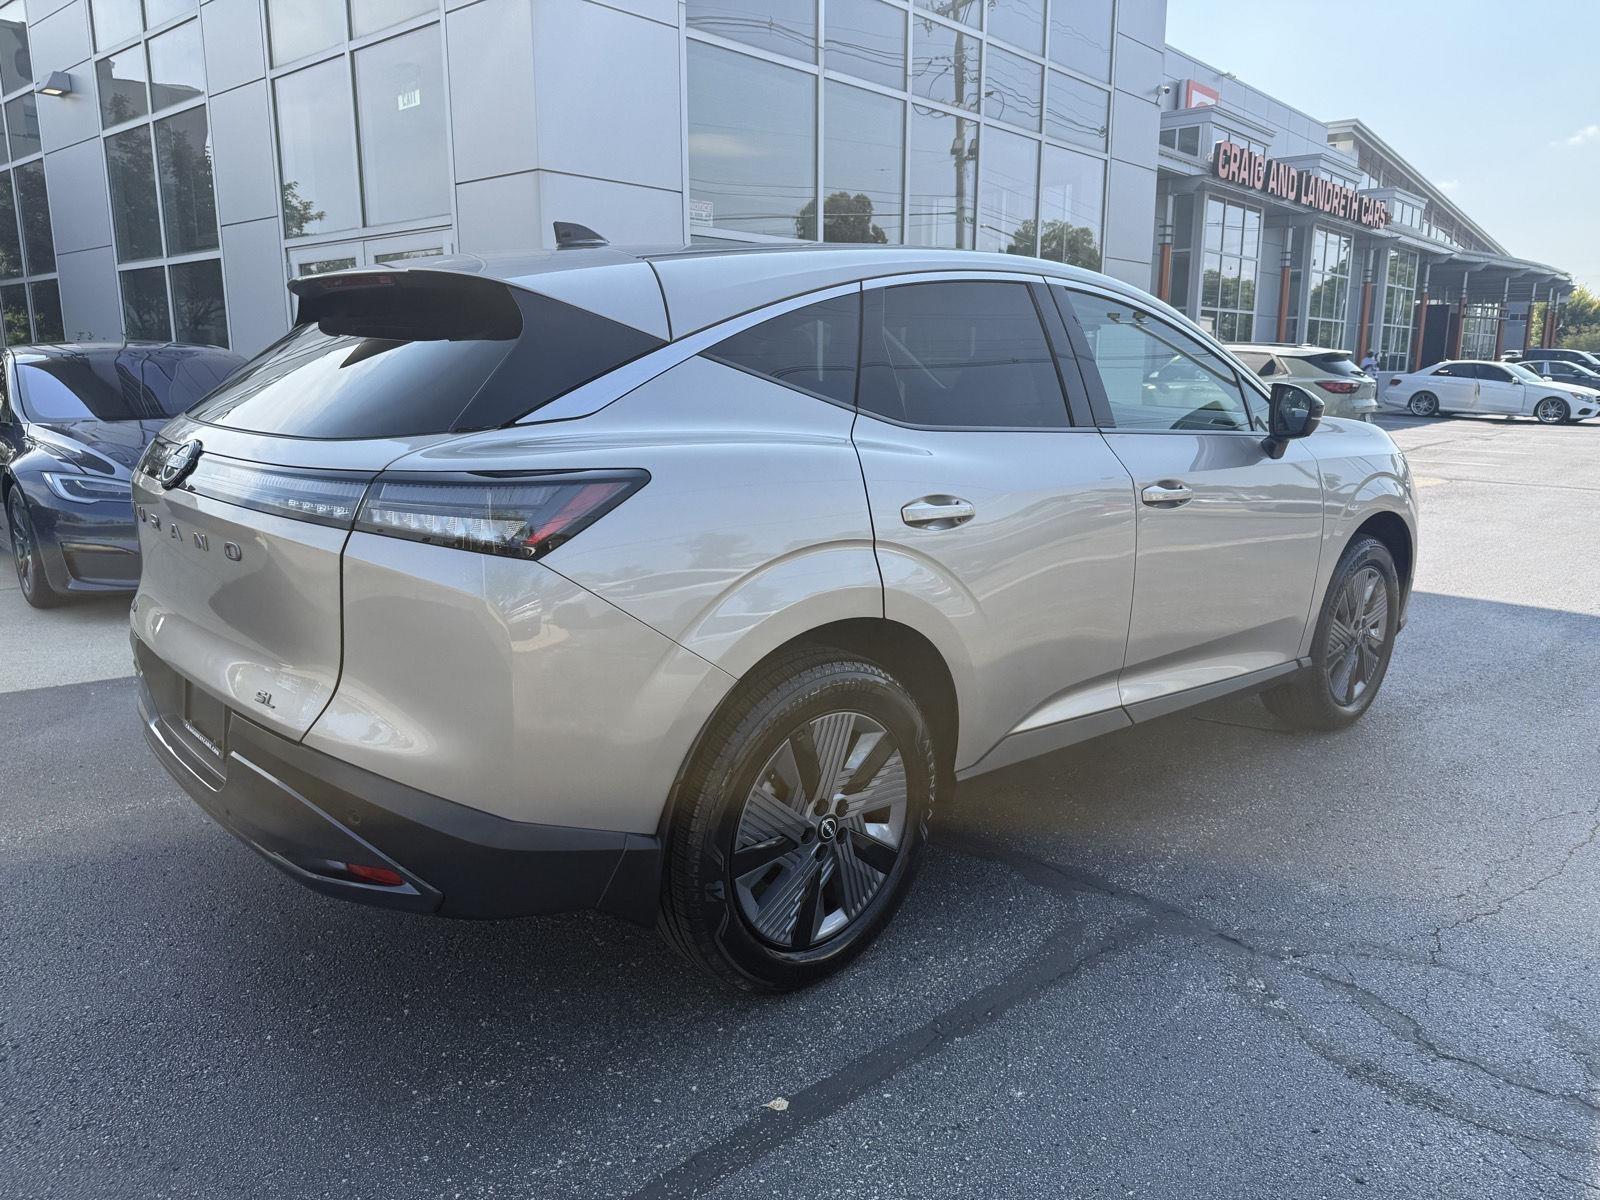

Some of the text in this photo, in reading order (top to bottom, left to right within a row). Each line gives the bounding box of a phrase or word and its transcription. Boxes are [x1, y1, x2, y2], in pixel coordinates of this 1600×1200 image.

[1216, 140, 1386, 229] CRAIG AND LANDRETH CARS
[255, 689, 275, 709] SL
